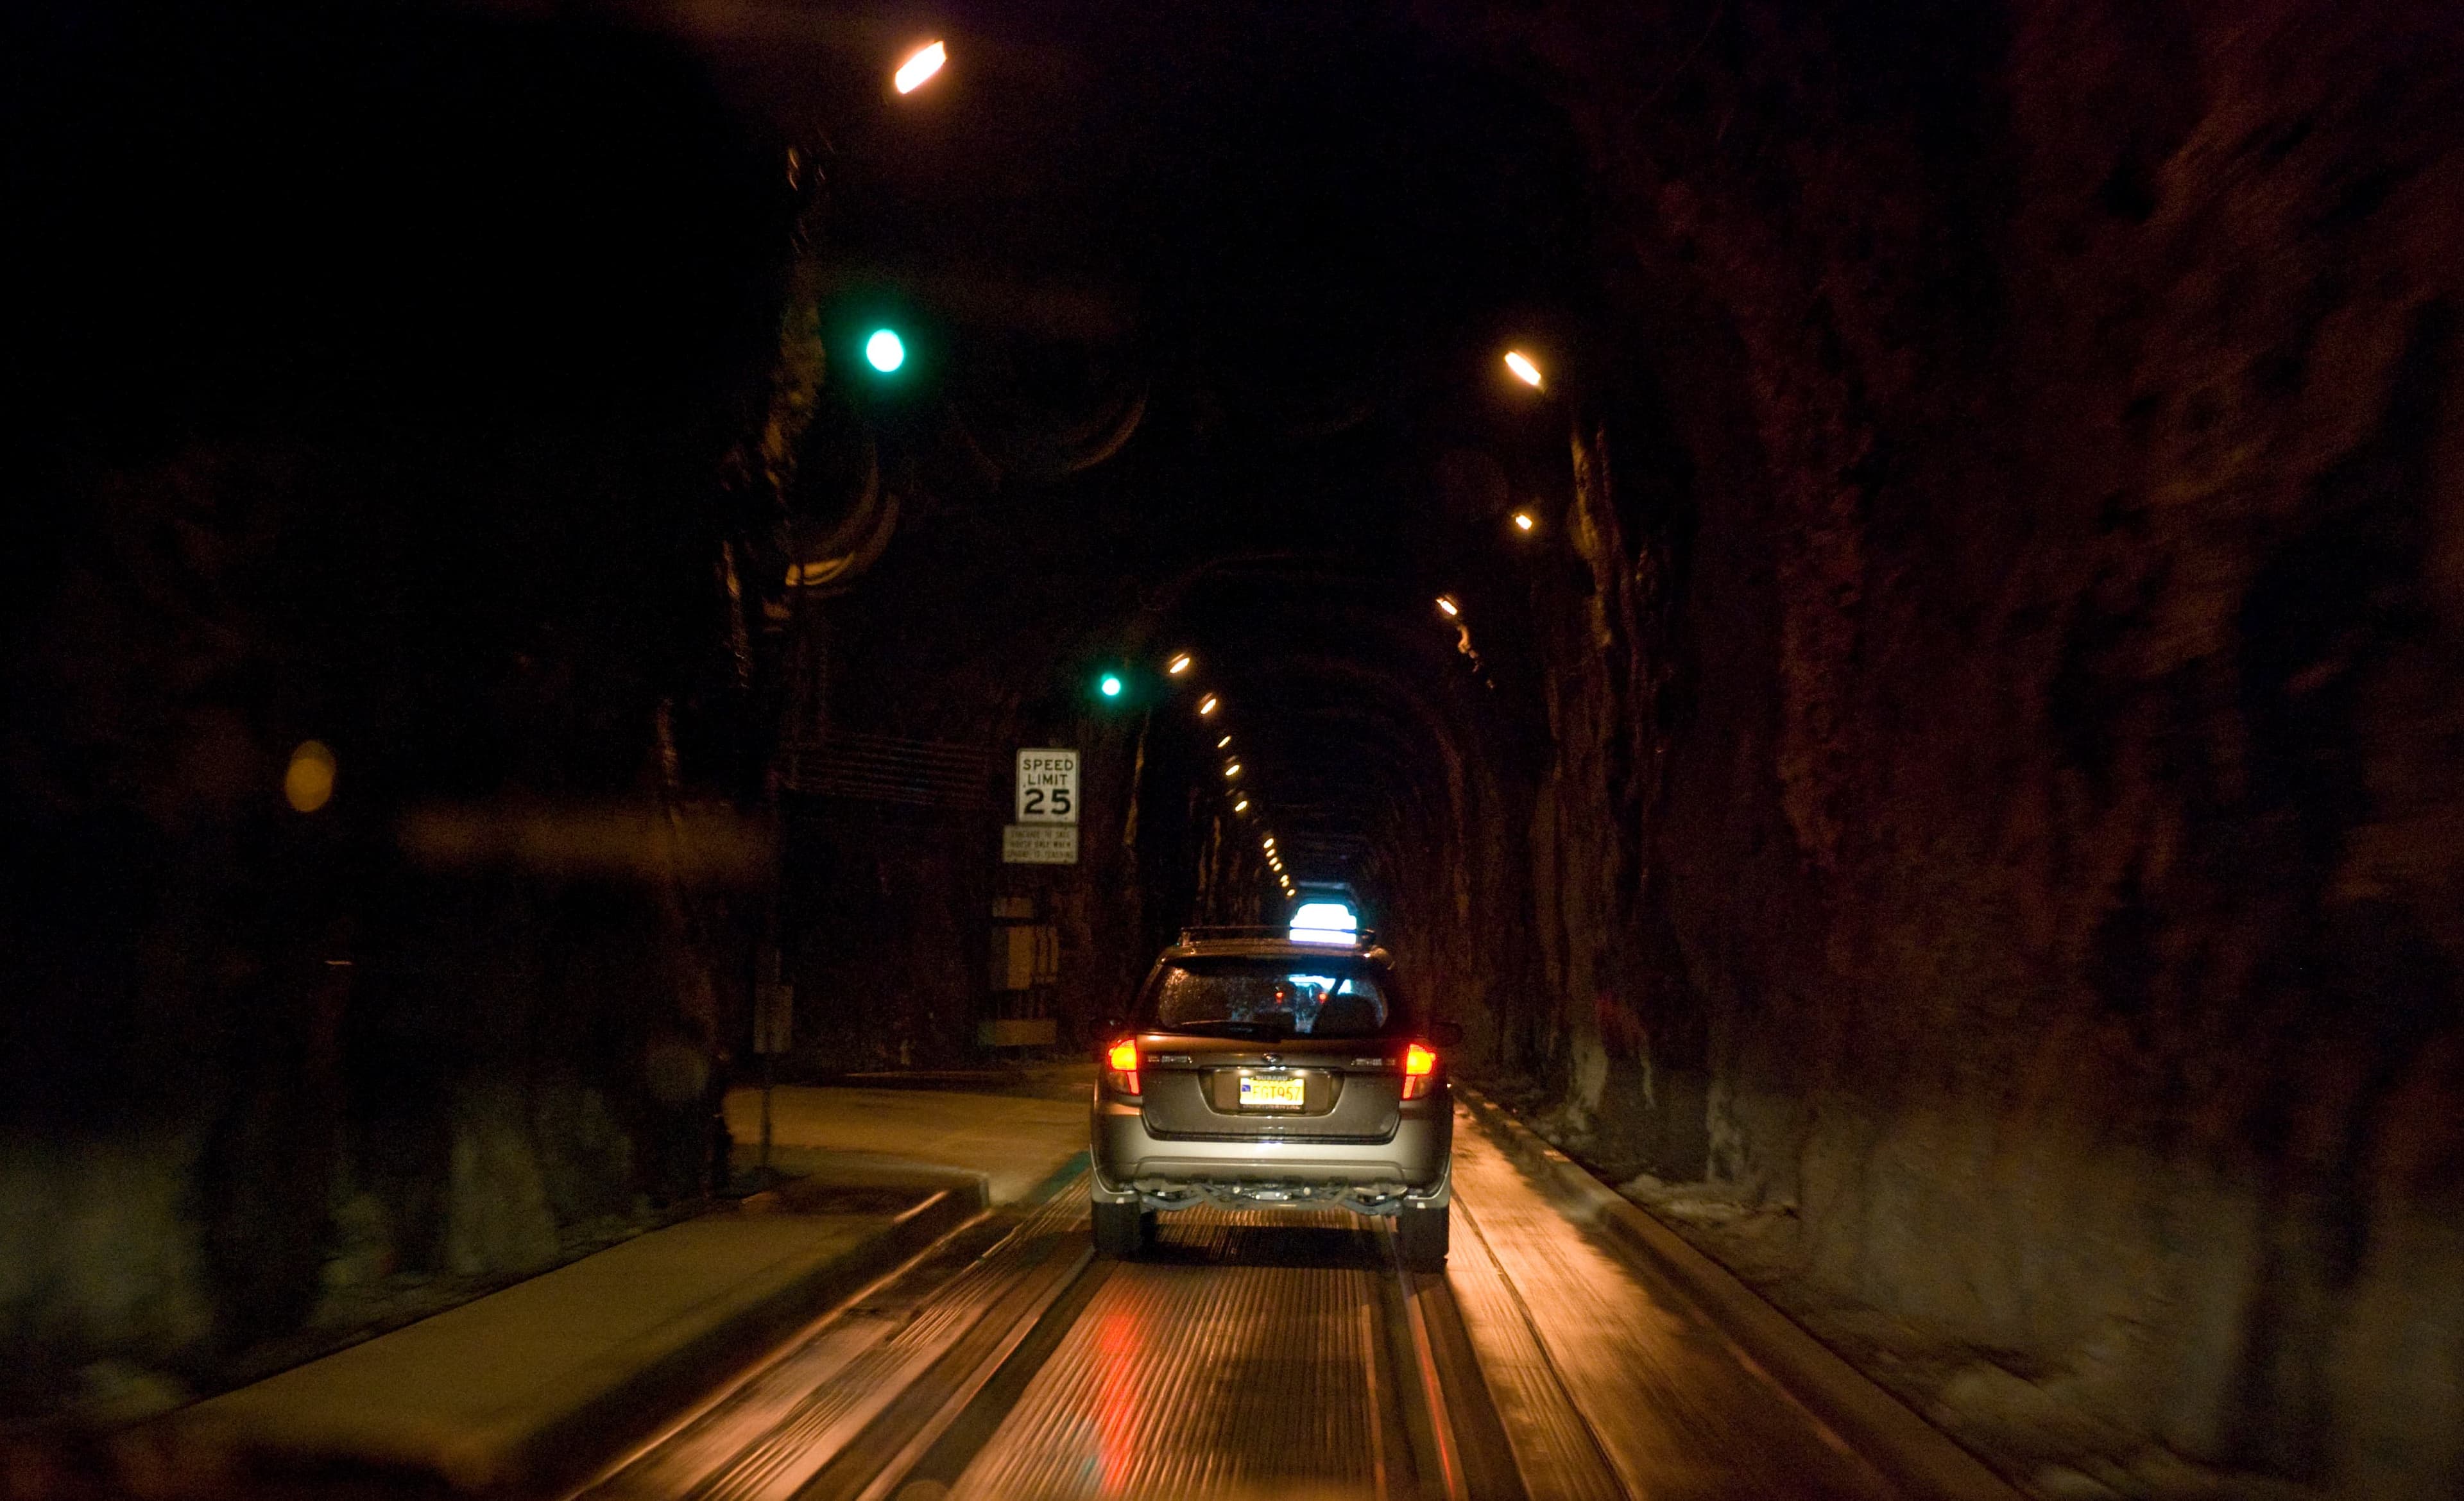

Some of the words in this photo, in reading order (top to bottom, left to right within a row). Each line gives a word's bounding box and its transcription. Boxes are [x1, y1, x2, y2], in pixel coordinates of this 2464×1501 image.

[1023, 759, 1074, 771] SPEED
[1028, 774, 1068, 785] LIMIT
[1023, 789, 1071, 815] 25
